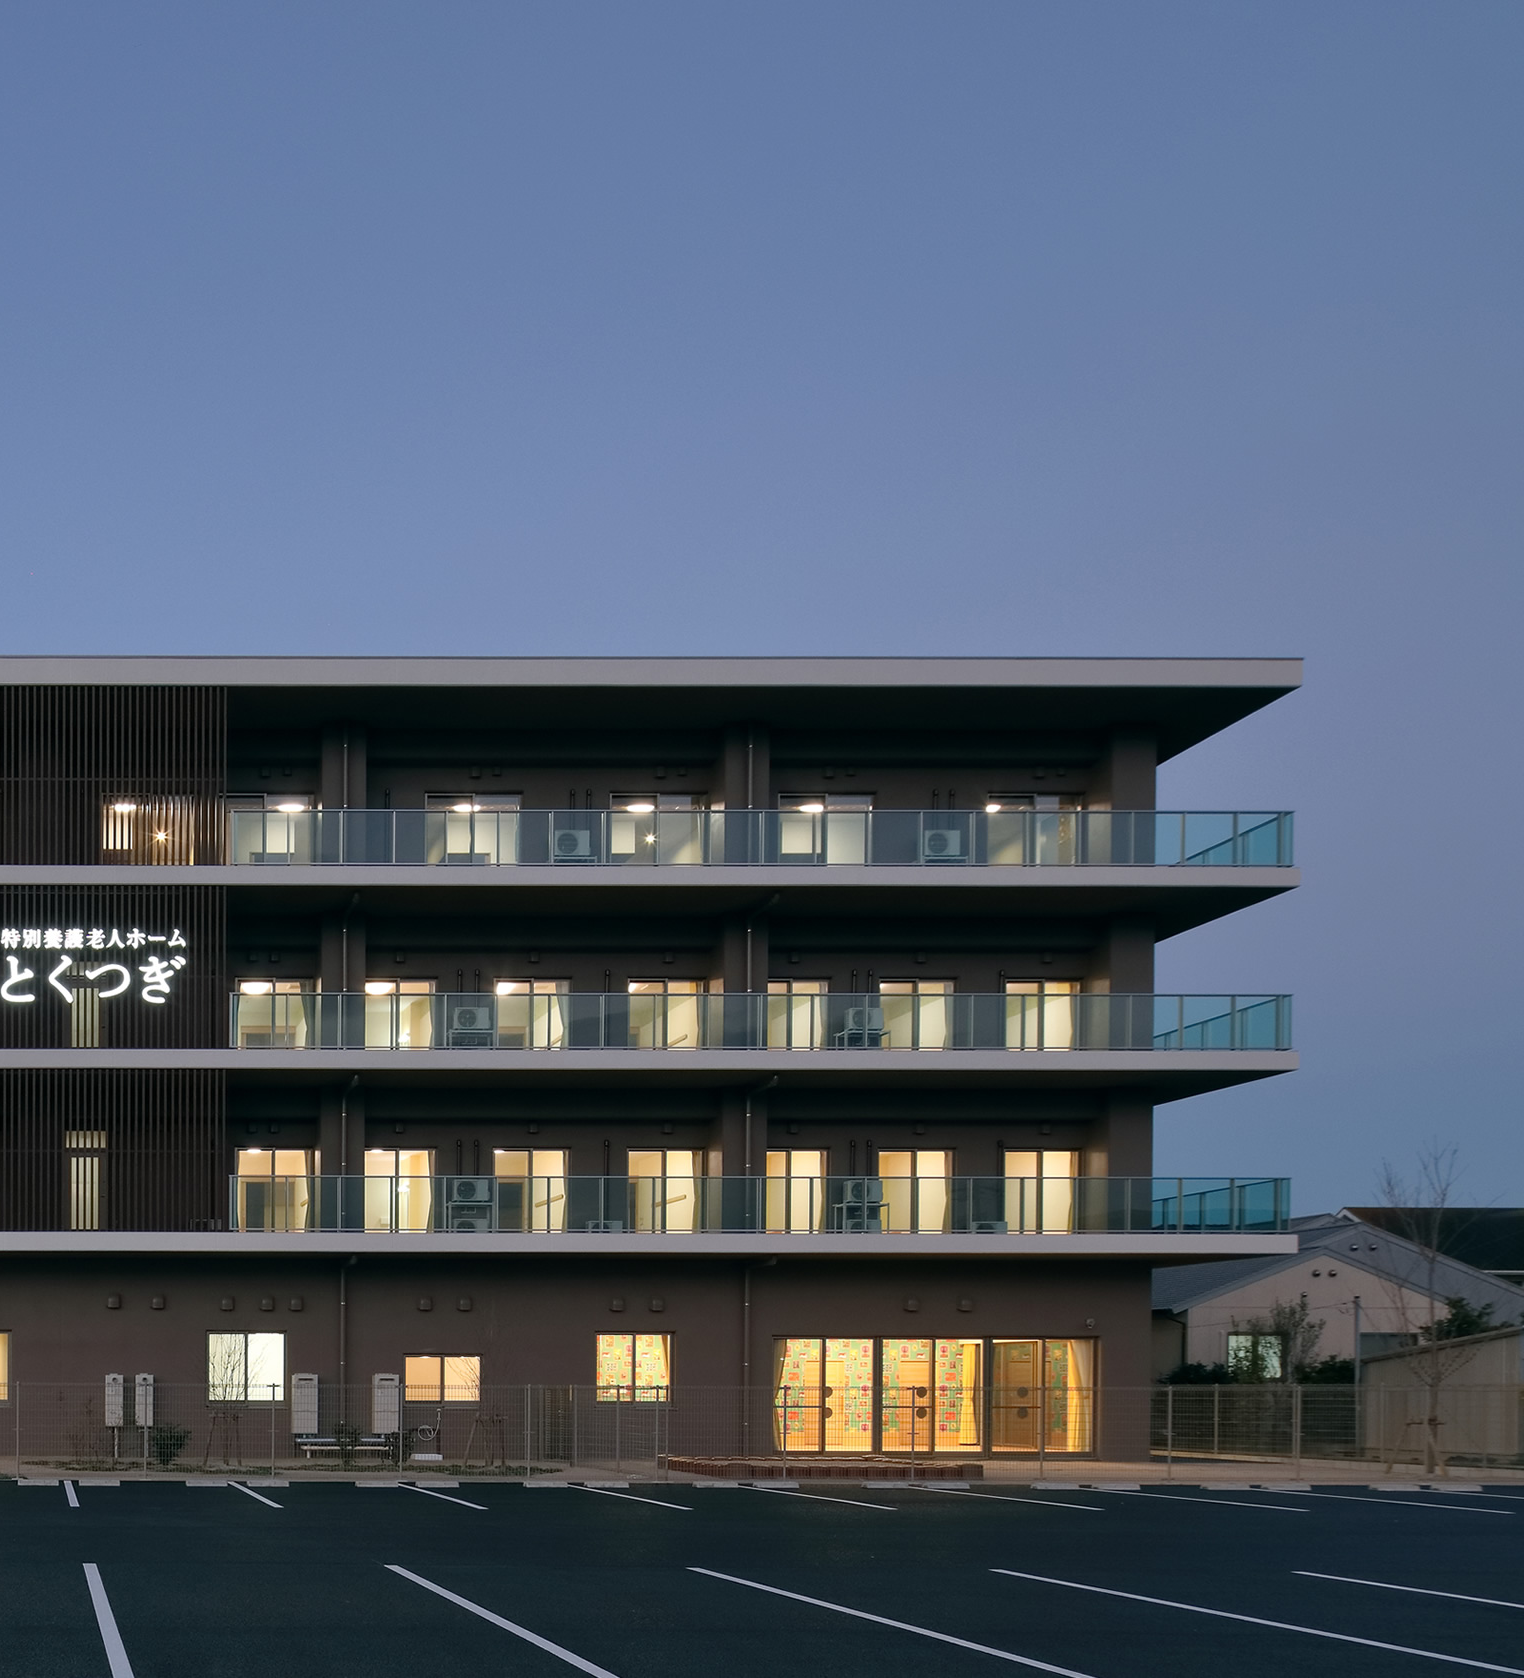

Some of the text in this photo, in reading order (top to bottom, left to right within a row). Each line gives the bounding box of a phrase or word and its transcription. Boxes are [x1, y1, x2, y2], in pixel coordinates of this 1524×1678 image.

[0, 927, 187, 949] 特別養護老人ホーム
[0, 954, 187, 1004] とくつぎ
